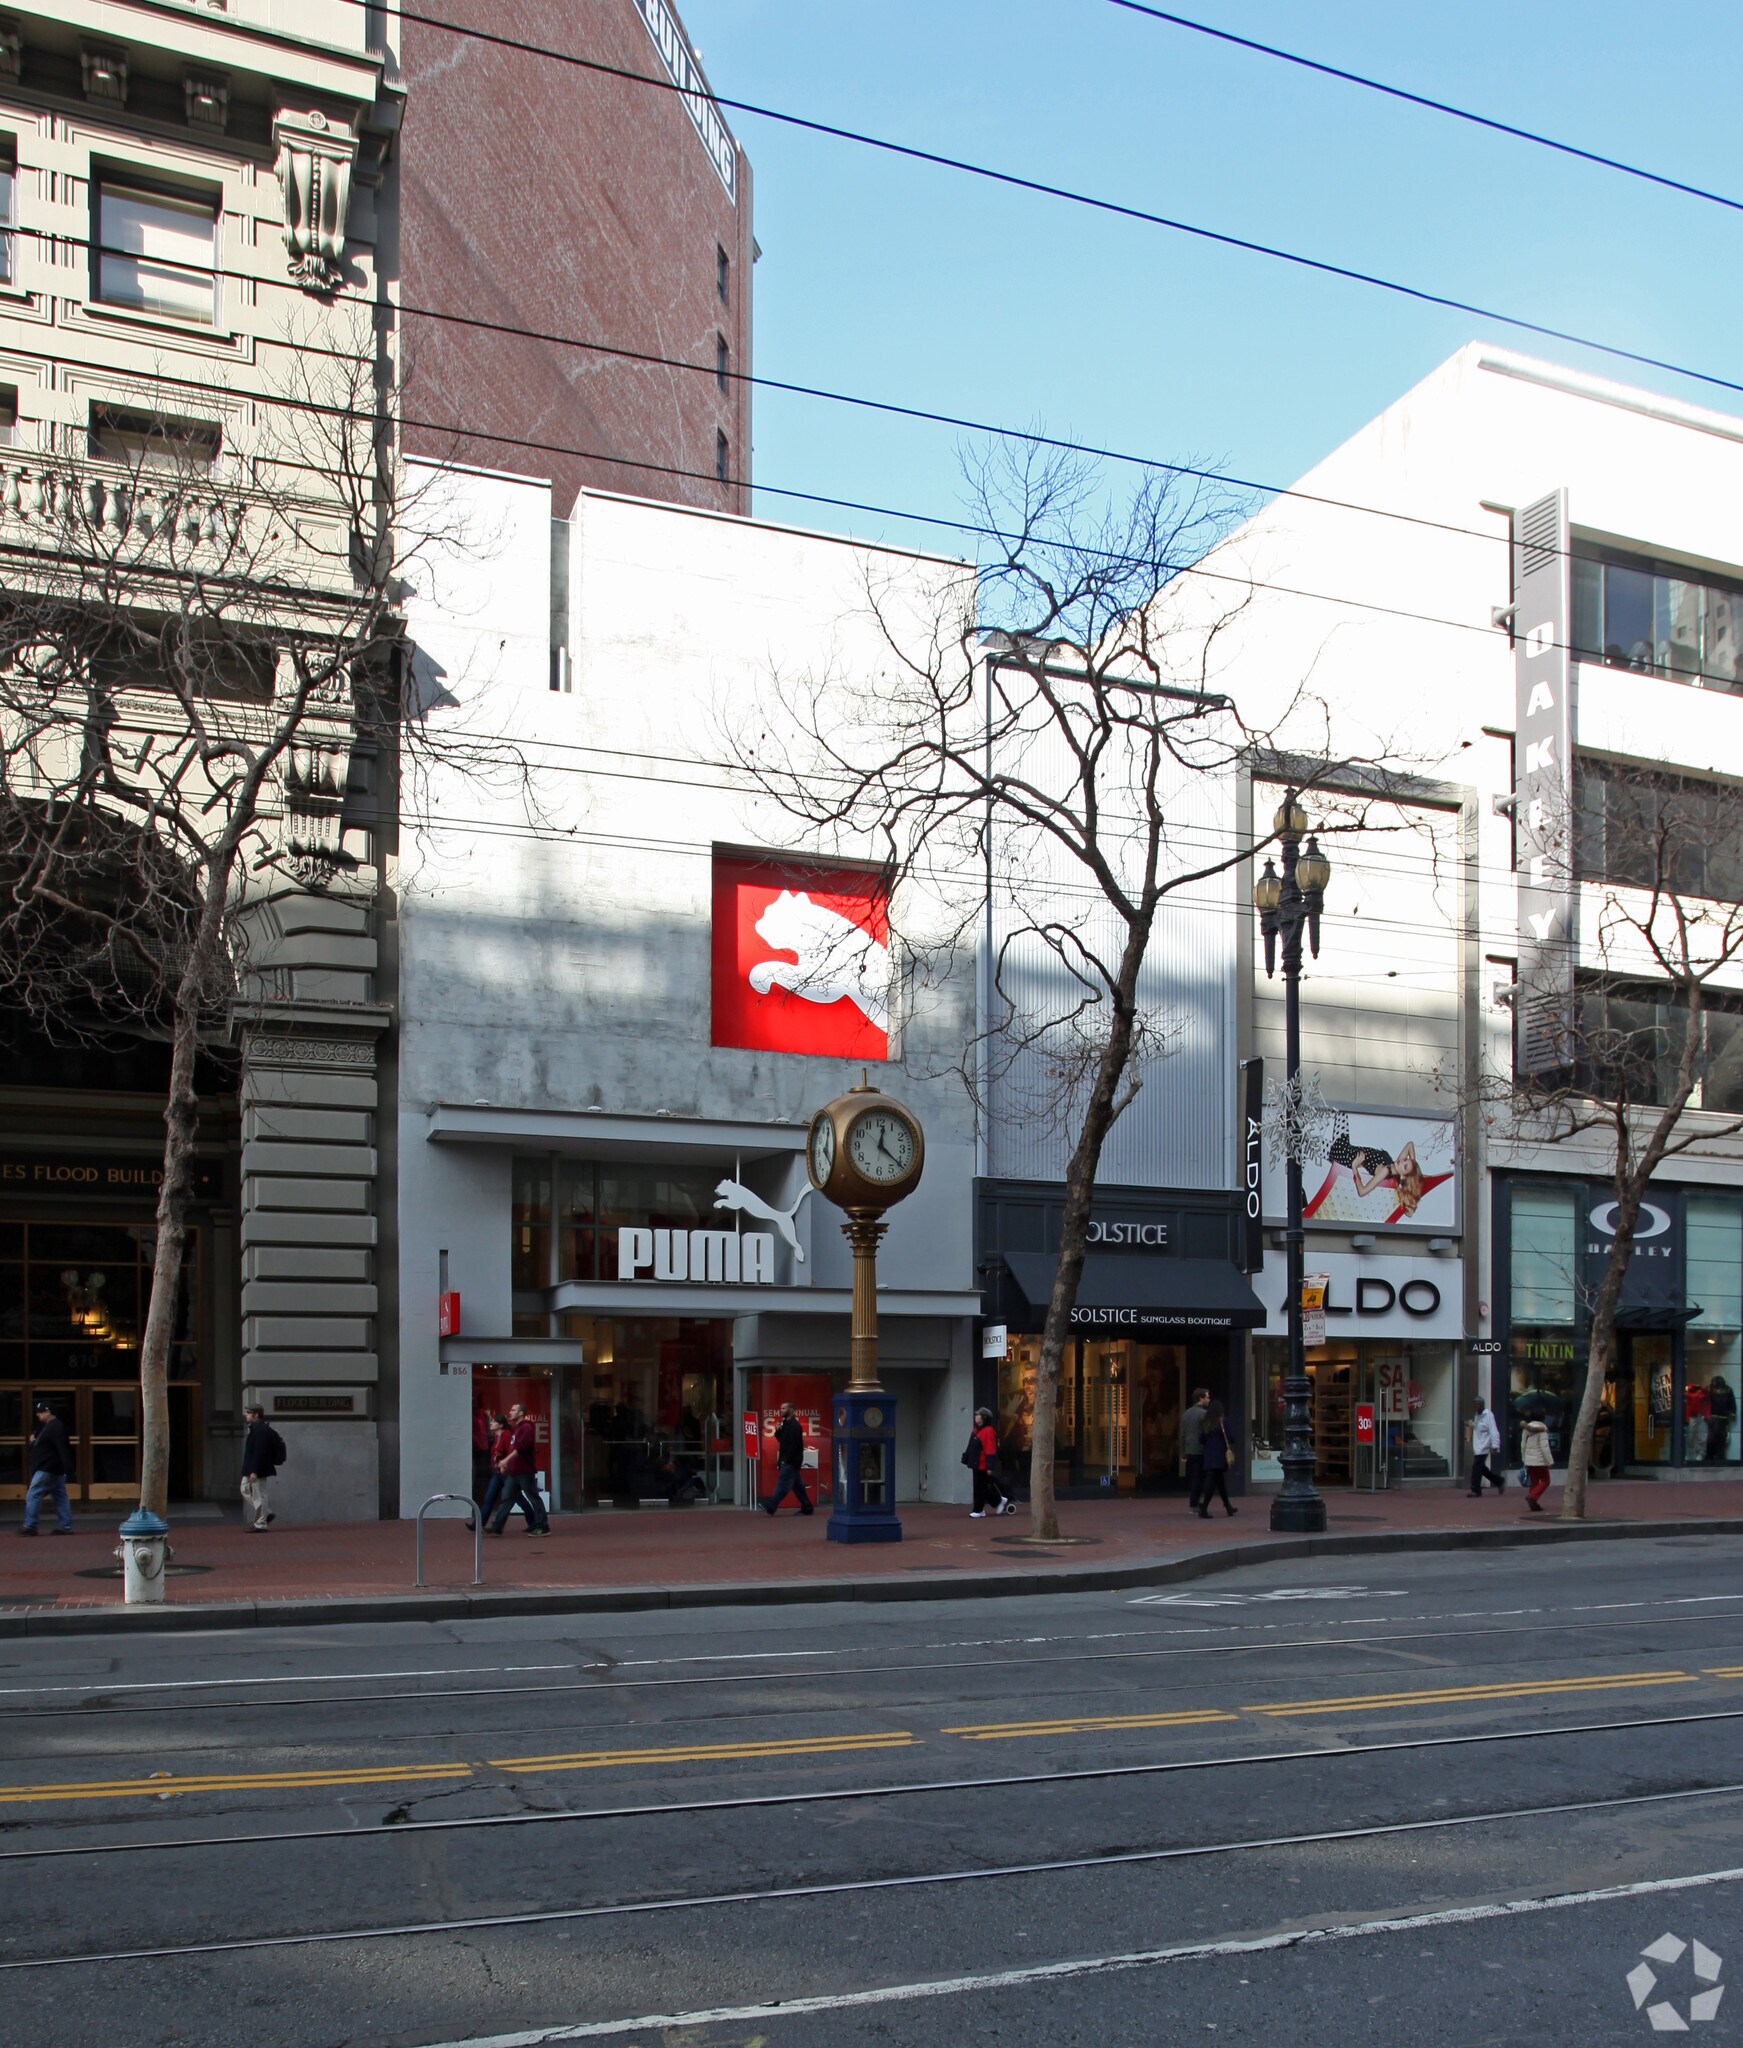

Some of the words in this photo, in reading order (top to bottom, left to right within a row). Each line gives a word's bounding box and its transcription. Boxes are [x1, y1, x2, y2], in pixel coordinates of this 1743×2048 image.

[645, 0, 732, 185] BUILDING
[1525, 620, 1557, 942] OAKLEY
[865, 1121, 872, 1130] 11
[889, 1123, 894, 1132] 1
[856, 1129, 865, 1139] 10
[897, 1132, 904, 1141] 2
[854, 1141, 860, 1150] 9
[899, 1145, 906, 1154] 3
[857, 1152, 865, 1162] 8
[864, 1162, 871, 1172] 7
[876, 1166, 883, 1176] 6
[887, 1164, 895, 1173] 5
[1247, 1116, 1260, 1218] ALDO
[34, 1165, 98, 1182] FLOOD
[1085, 1221, 1168, 1245] OLSTICE
[618, 1227, 775, 1283] PUMA
[1280, 1277, 1441, 1316] LDO
[1070, 1307, 1137, 1323] SOLSTICE
[1140, 1315, 1185, 1325] SUNGLASS
[1187, 1316, 1232, 1326] BOUTIQUE
[1472, 1342, 1502, 1352] ALDO
[1525, 1343, 1575, 1359] TINTIN
[452, 1366, 468, 1376] 856
[1379, 1364, 1406, 1388] SA
[744, 1424, 757, 1435] SALE
